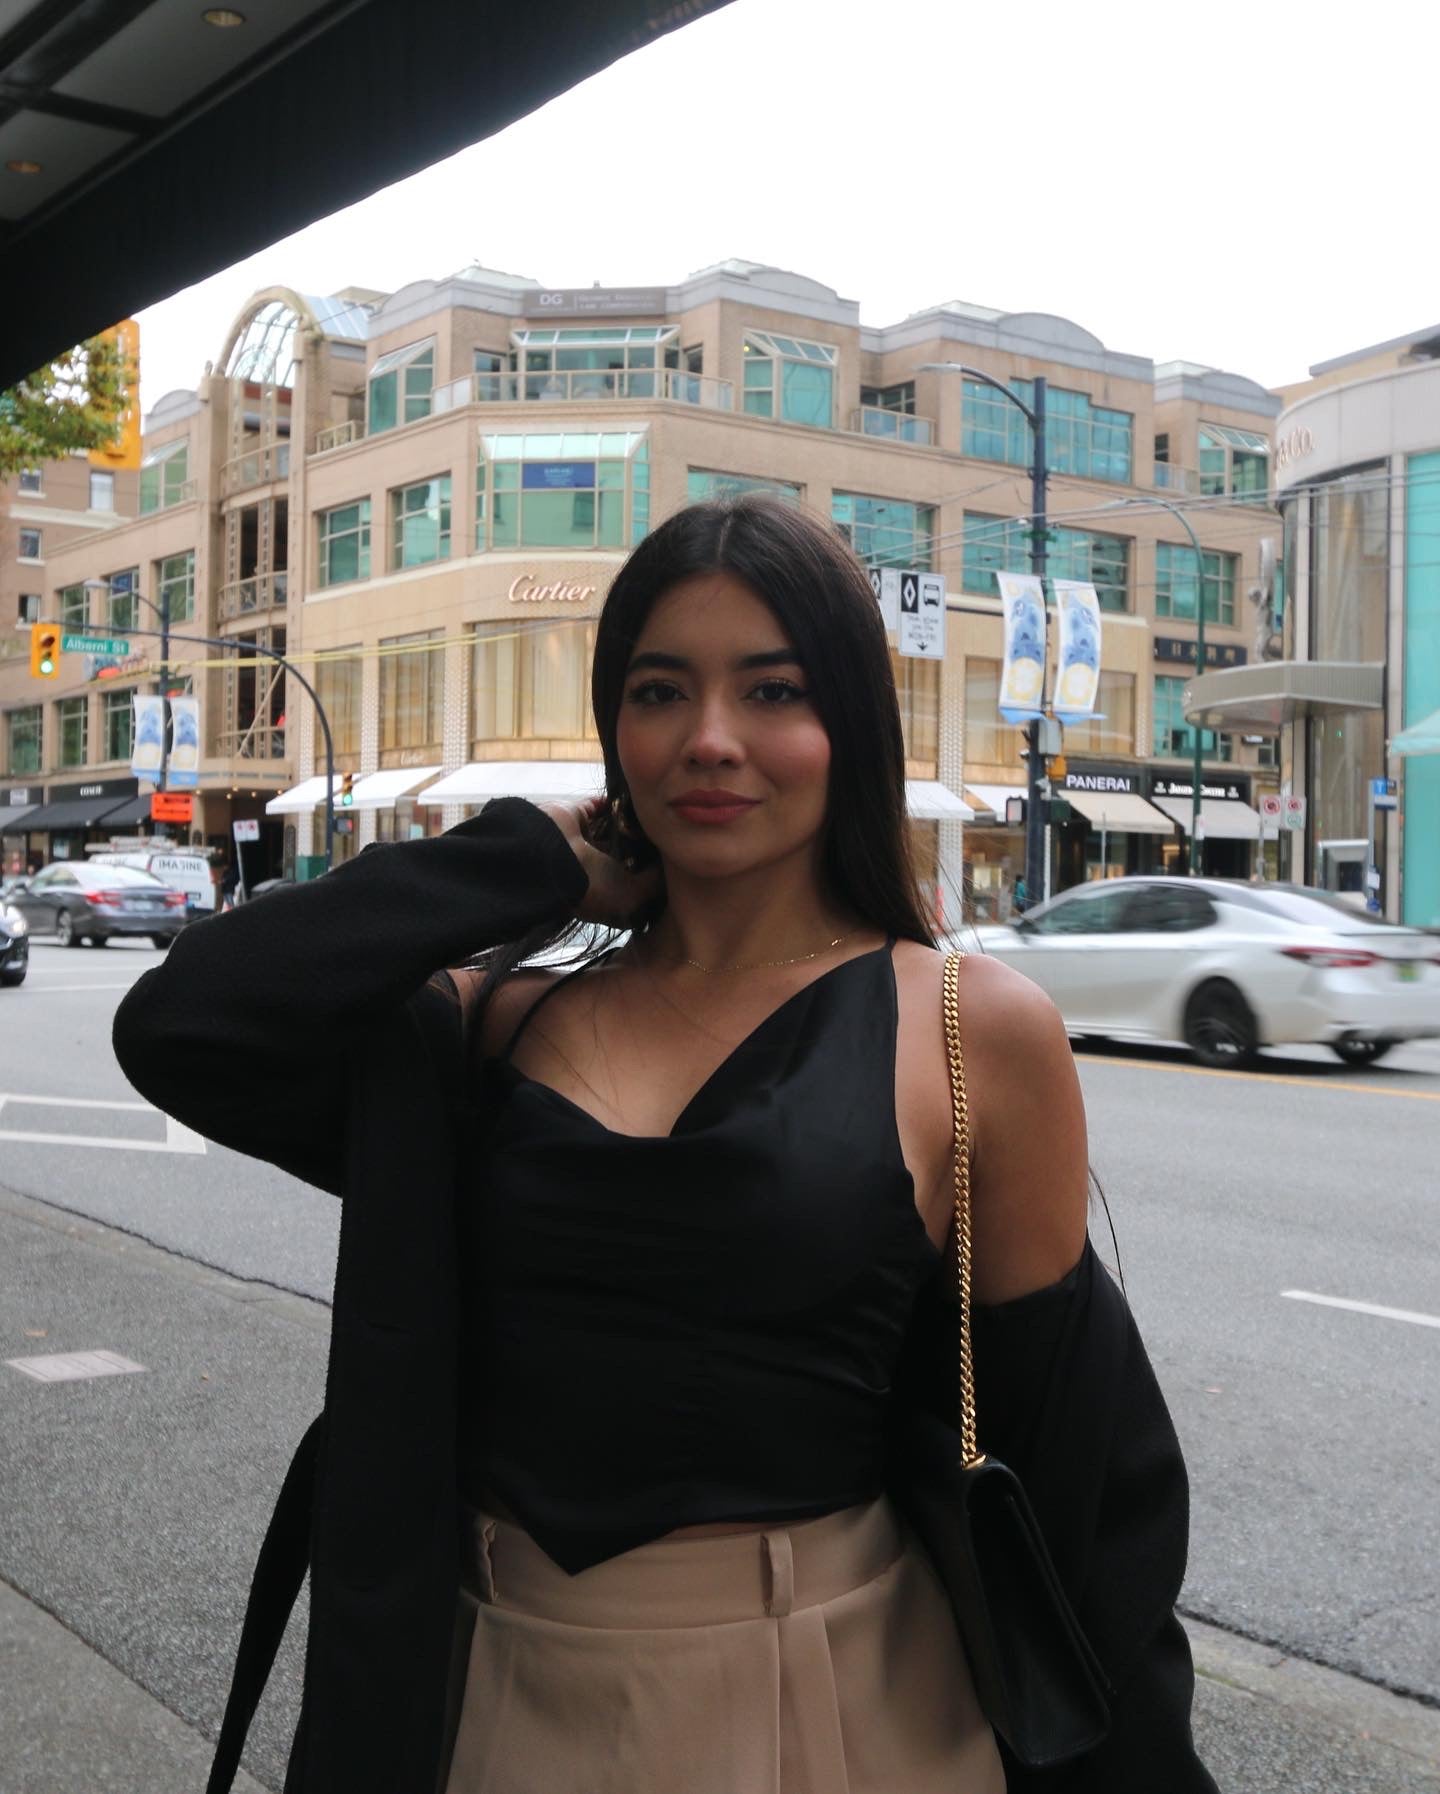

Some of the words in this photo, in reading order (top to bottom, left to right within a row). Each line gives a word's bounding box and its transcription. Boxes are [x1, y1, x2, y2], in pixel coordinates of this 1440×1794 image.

[540, 294, 563, 305] DG
[508, 575, 596, 601] Cartier
[66, 638, 107, 652] Alberni
[112, 641, 125, 653] St
[1066, 774, 1131, 792] PANERAI
